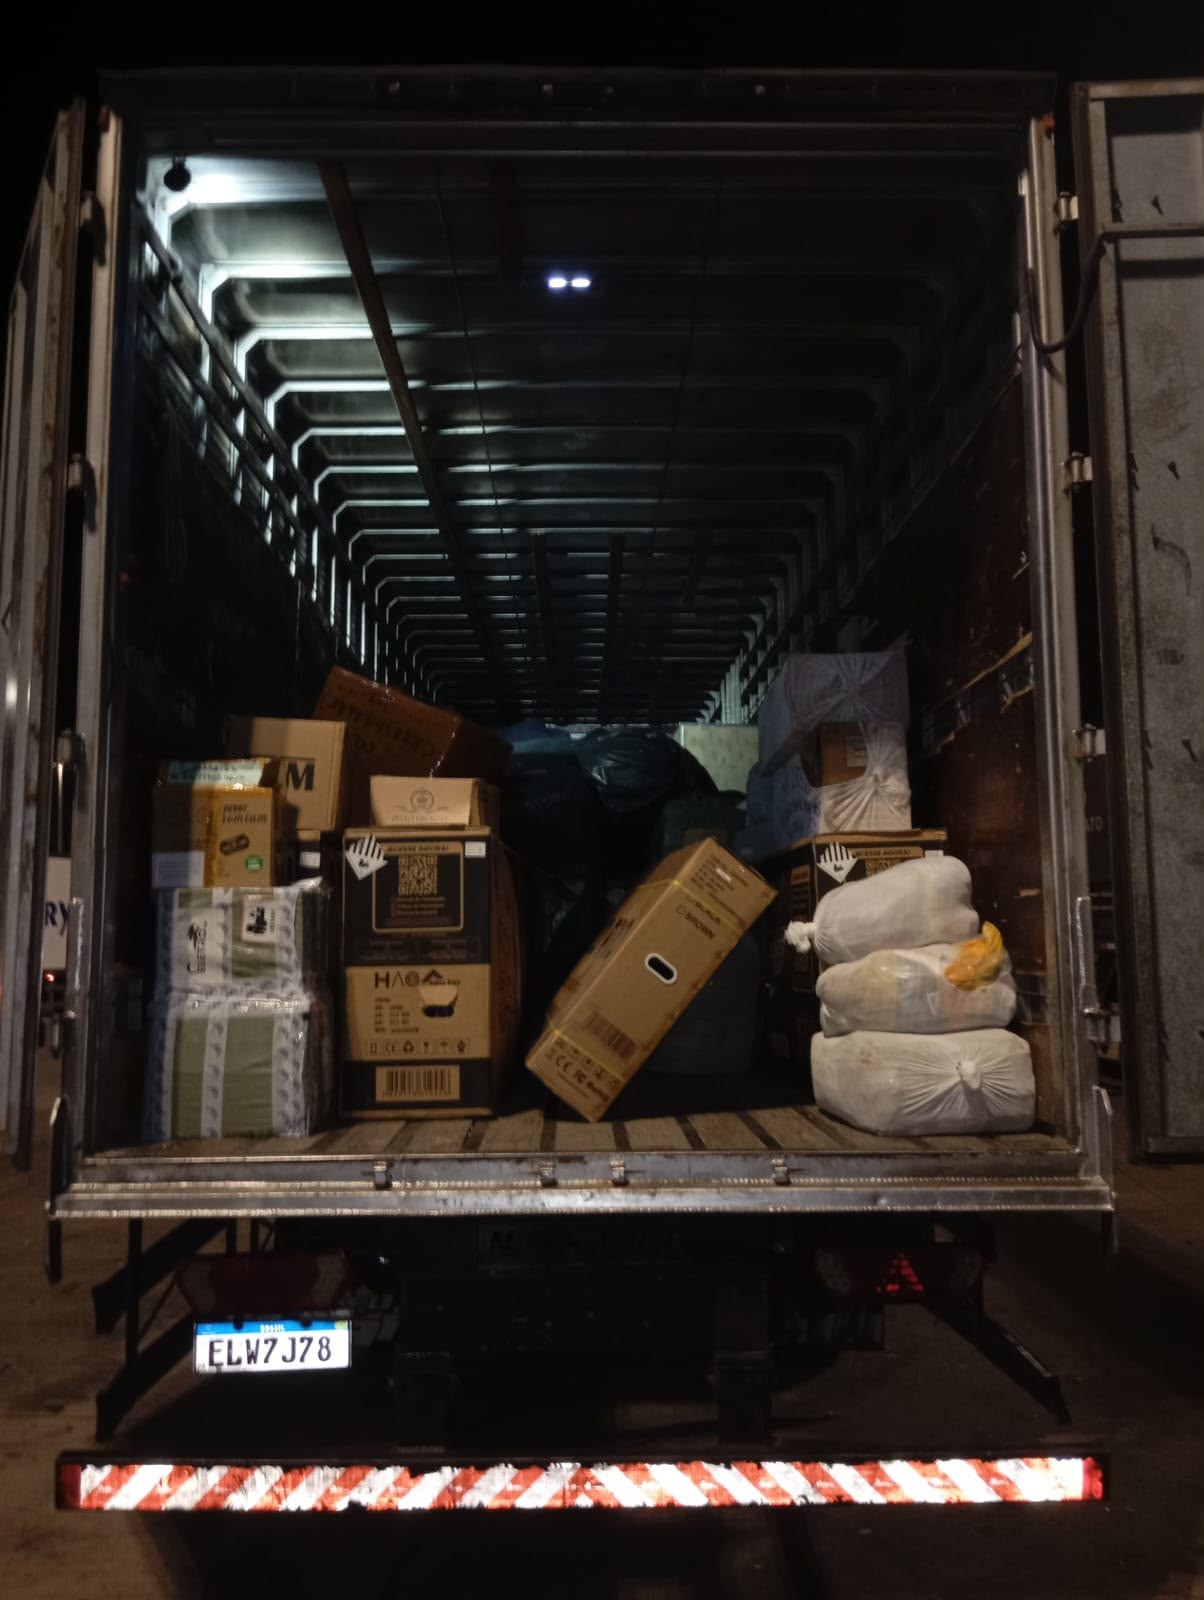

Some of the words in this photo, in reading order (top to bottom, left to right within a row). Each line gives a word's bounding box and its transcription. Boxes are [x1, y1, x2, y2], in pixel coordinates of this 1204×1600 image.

[286, 761, 315, 791] M
[685, 911, 715, 940] BROWN
[208, 1335, 332, 1367] ELW7J78
